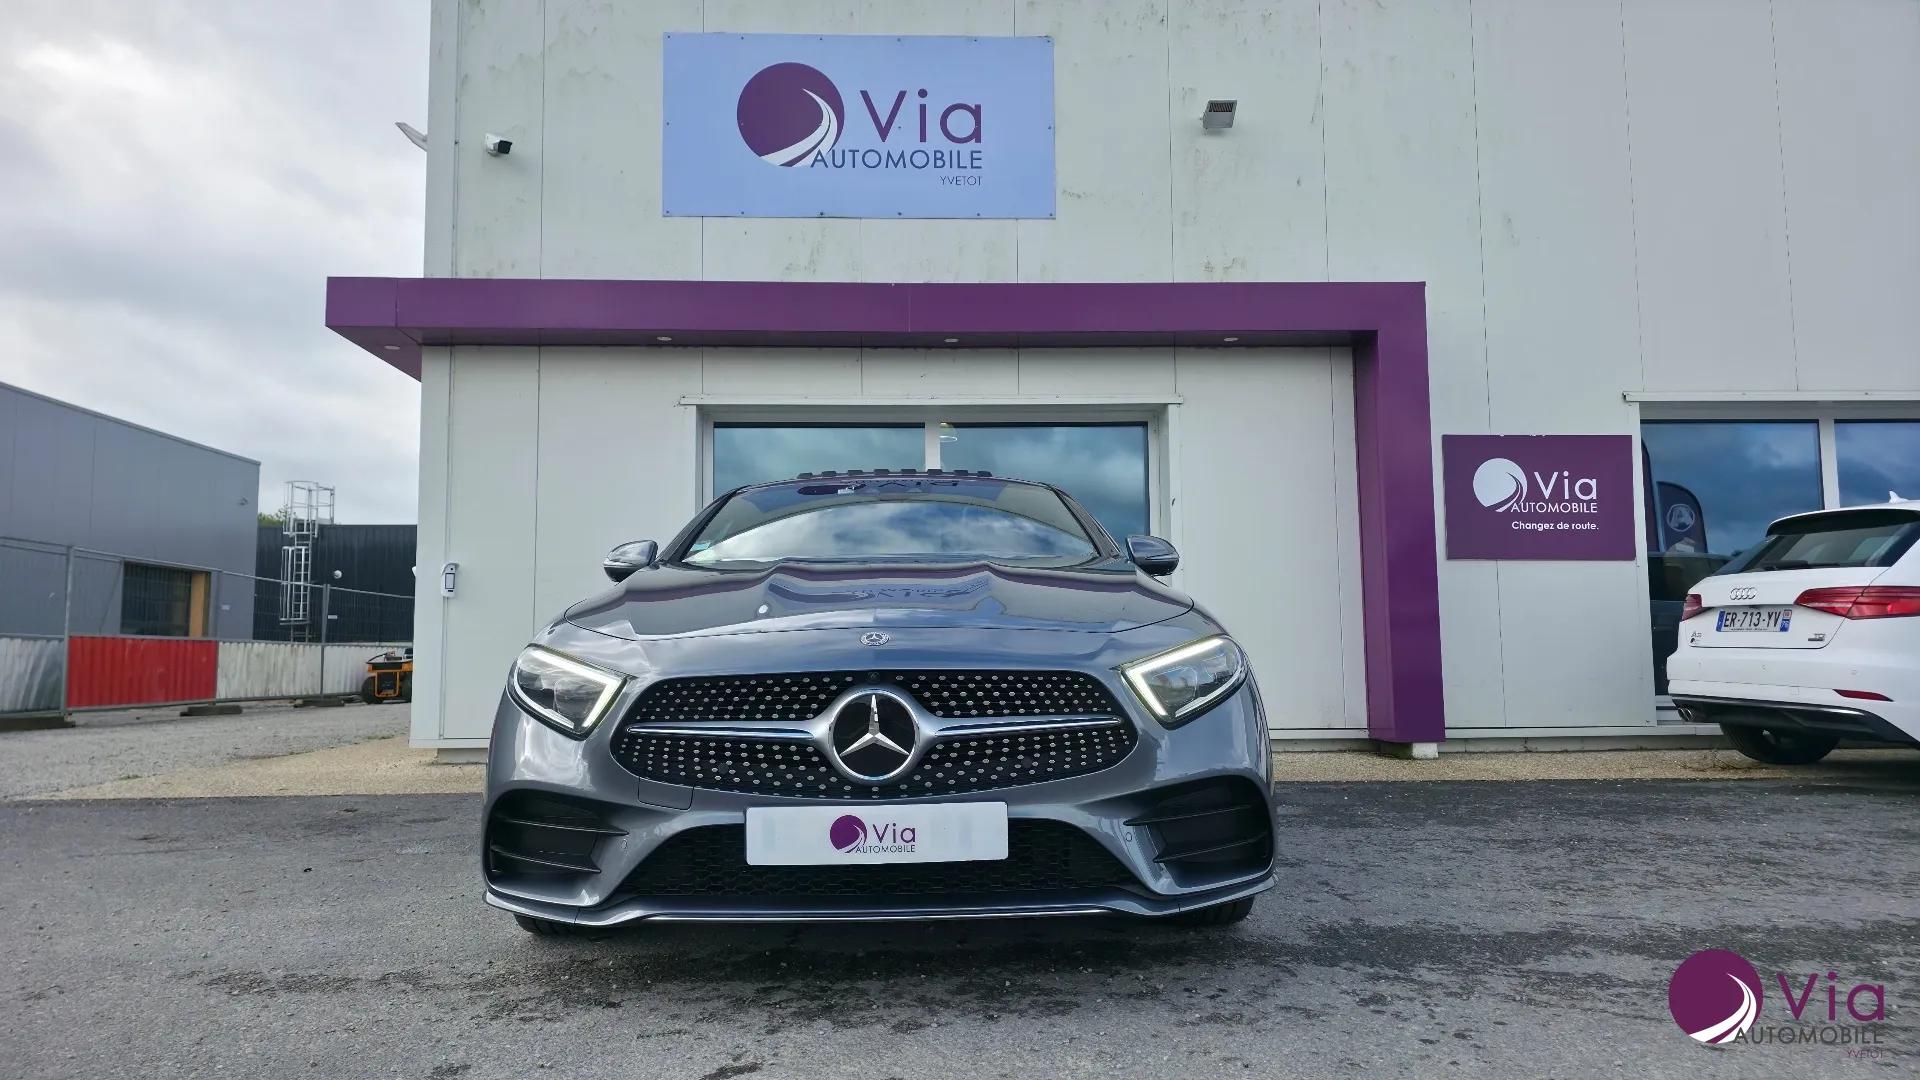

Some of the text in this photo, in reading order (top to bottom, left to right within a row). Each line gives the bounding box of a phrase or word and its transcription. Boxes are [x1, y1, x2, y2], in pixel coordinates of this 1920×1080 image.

[859, 88, 982, 144] Via
[810, 149, 983, 169] AUTOMOBILE
[940, 175, 982, 186] YVETOT
[1533, 470, 1597, 500] Via
[1511, 502, 1598, 513] AUTOMOBILE
[1511, 521, 1599, 531] Changez de route.
[1723, 611, 1781, 627] ER-713-YV
[872, 823, 916, 843] Via
[855, 844, 916, 853] AUTOMOBILE
